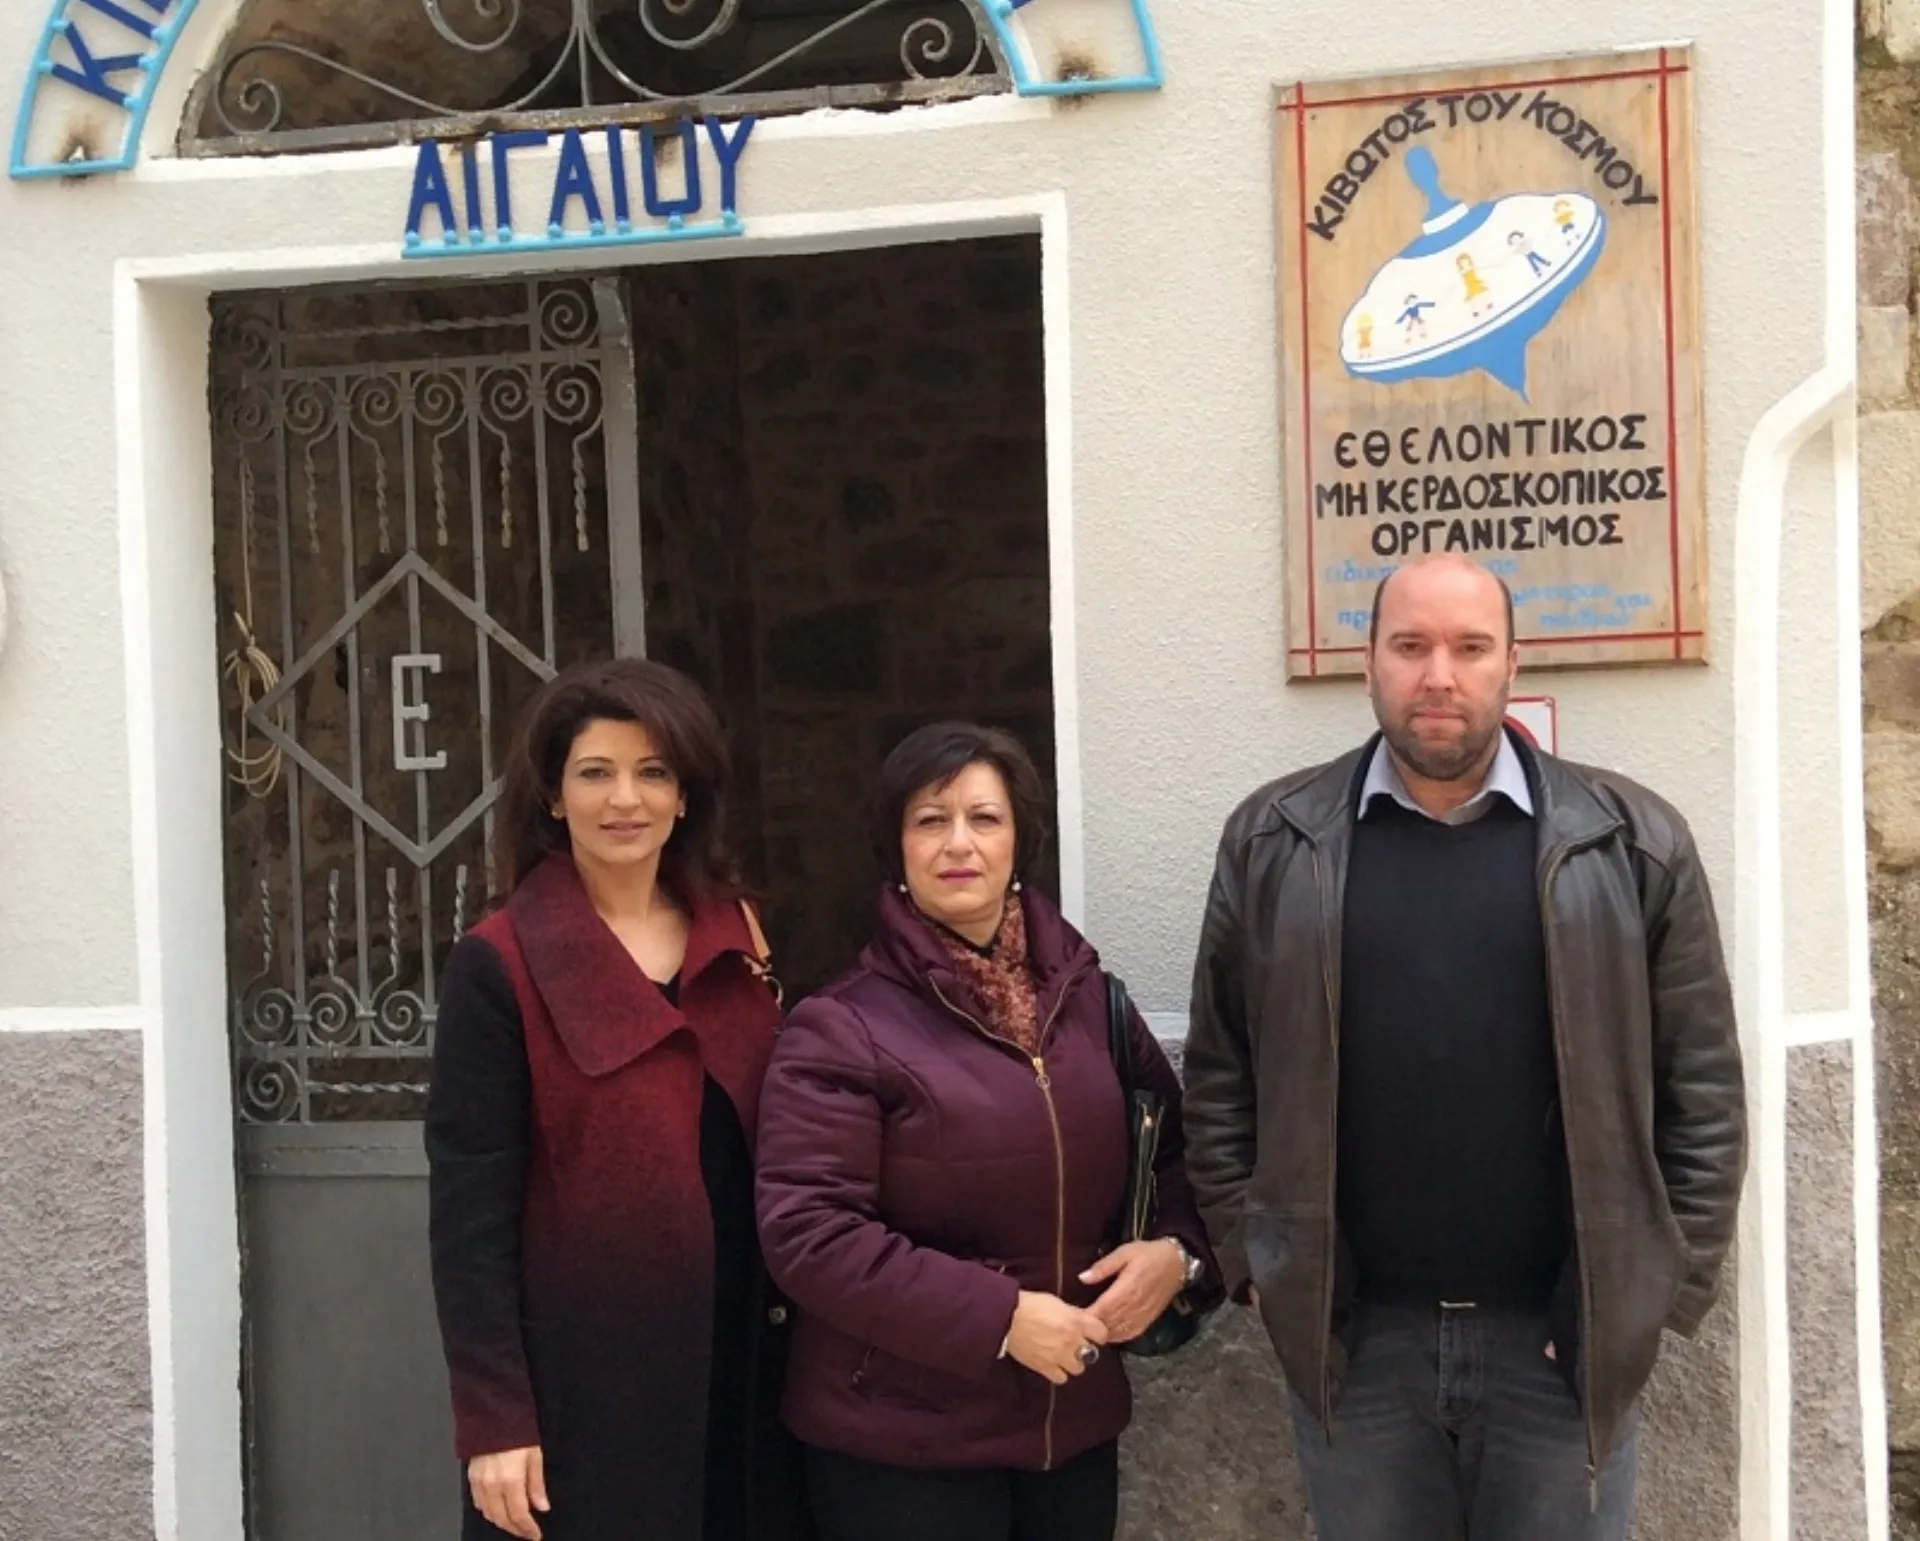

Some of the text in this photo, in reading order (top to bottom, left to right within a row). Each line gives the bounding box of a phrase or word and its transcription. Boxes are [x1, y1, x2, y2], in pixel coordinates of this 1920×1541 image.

[50, 0, 172, 108] ΚΙ
[404, 114, 757, 244] ΑΙΓΑΙΟΥ
[1306, 90, 1659, 241] ΚΙΒΩΤΟΣ ΤΟΥ ΚΟΣΜΟΥ
[1333, 413, 1648, 469] ΕΘΕΛΟΝΤΙΚΟΣ
[1315, 465, 1668, 519] ΜΗ ΚΕΡΔΟΣΚΟΠΙΚΟΣ
[1371, 513, 1624, 556] ΟΡΓΑΝΙΣΜΟΣ
